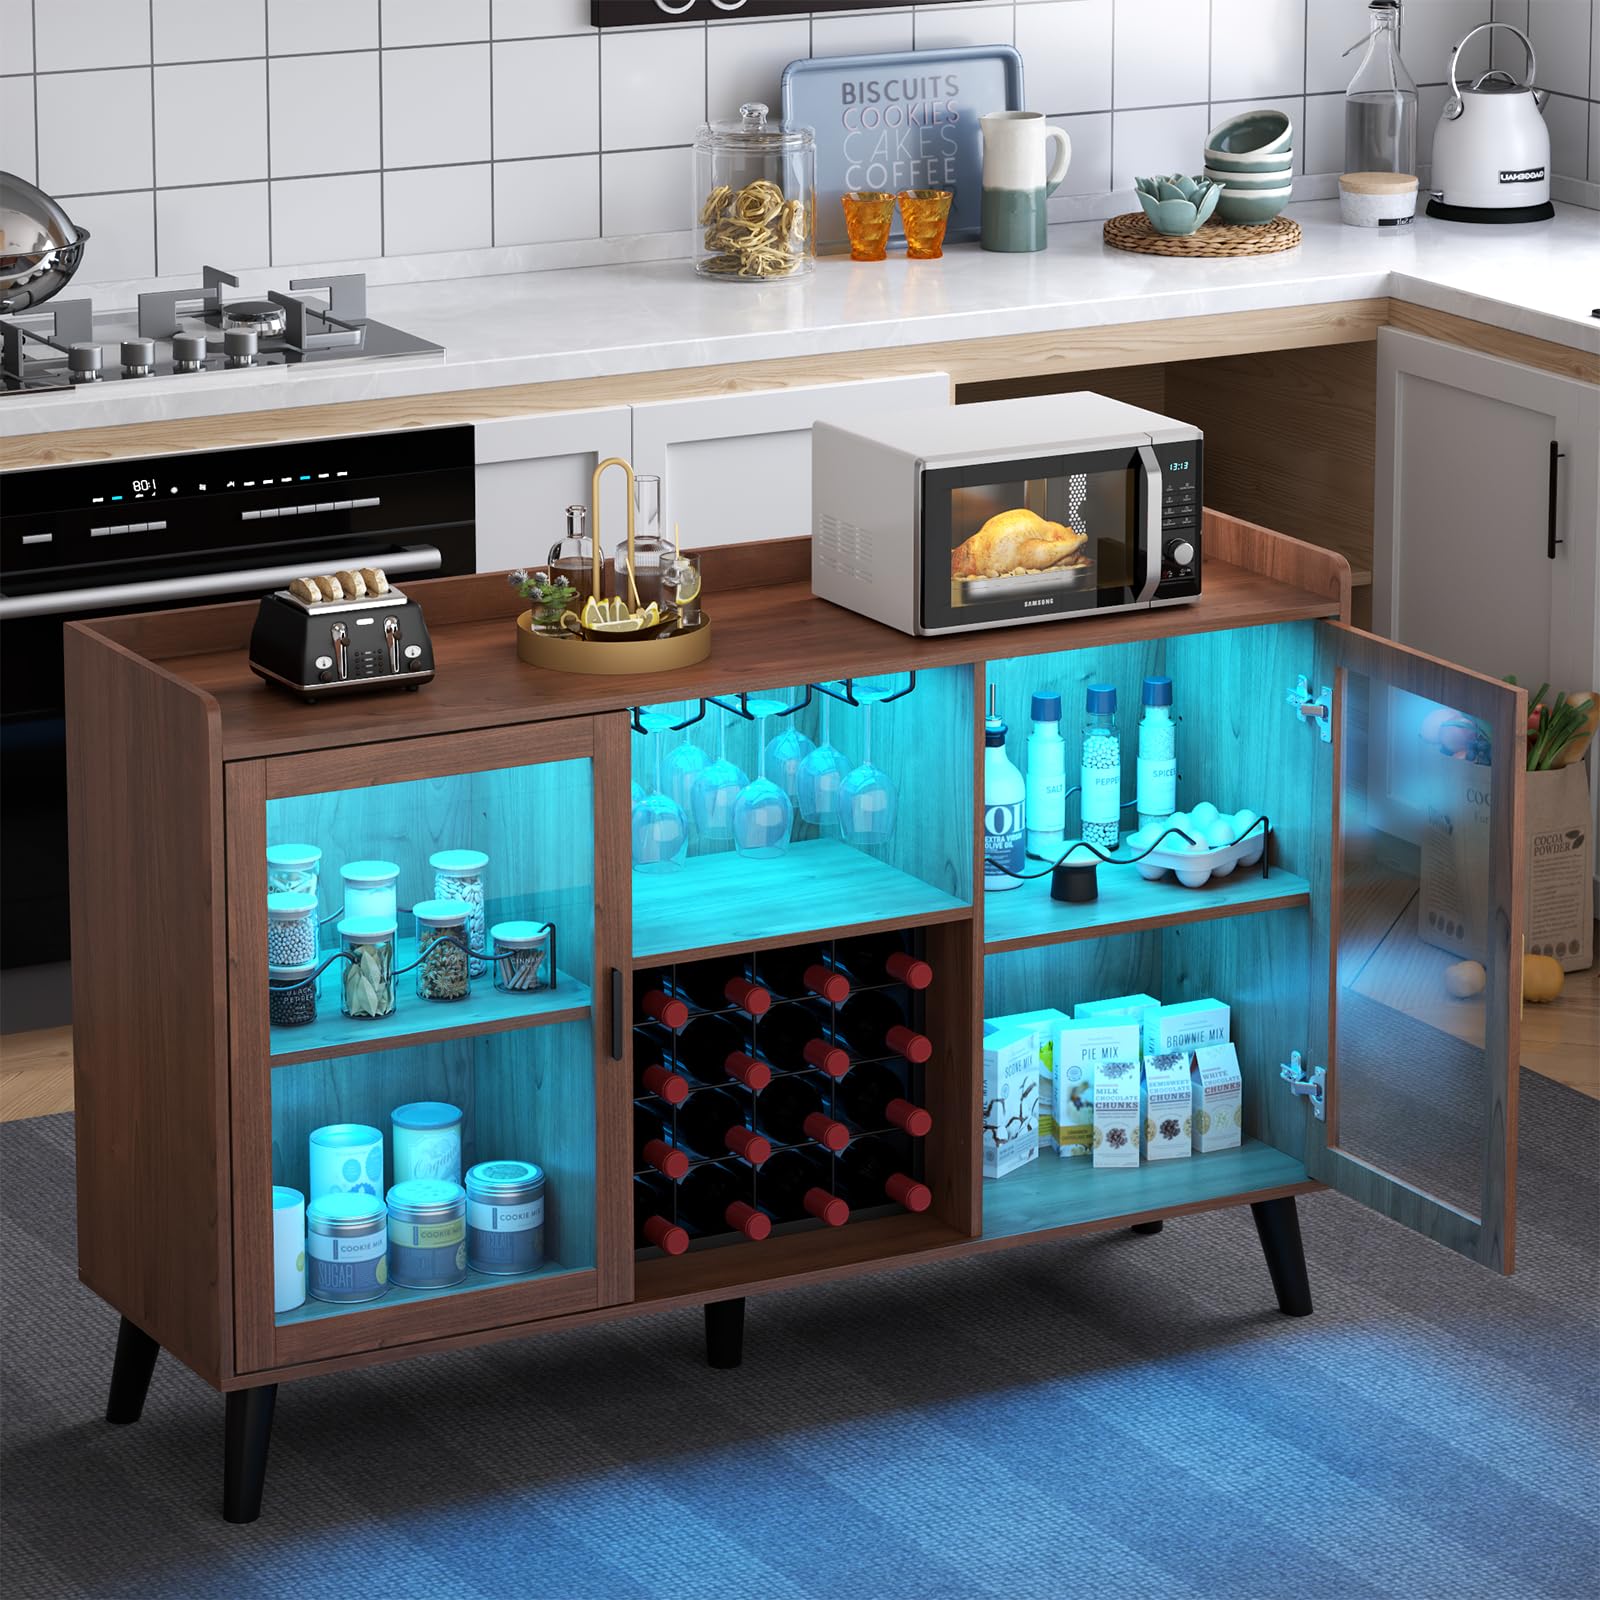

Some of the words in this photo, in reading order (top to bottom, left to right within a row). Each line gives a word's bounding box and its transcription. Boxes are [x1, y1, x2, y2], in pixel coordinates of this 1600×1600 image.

[842, 75, 960, 105] BISCUITS
[842, 100, 960, 131] COOKIES
[843, 124, 958, 164] CAKES
[845, 157, 957, 191] COFFEE
[1169, 461, 1189, 471] 13:13
[1024, 598, 1054, 607] SAMSUNG
[1046, 783, 1063, 794] SALT
[1534, 833, 1563, 847] COCOA
[1534, 842, 1570, 857] POWDER
[1166, 1030, 1205, 1049] BROWNIE
[1208, 1027, 1225, 1041] MIX
[1081, 1047, 1097, 1061] PIE
[1101, 1047, 1119, 1059] MIX
[1004, 1062, 1021, 1079] SCONE
[1023, 1055, 1033, 1070] MIX
[1202, 1070, 1228, 1080] WHITE
[1204, 1081, 1242, 1094] CHUNKS
[1149, 1092, 1191, 1102] CHUNKS
[1095, 1101, 1139, 1109] CHUNKS
[500, 1210, 529, 1221] COOKIE
[420, 1229, 449, 1239] COOKIE
[340, 1242, 371, 1253] COOKIE
[318, 1263, 353, 1289] SUGAR
